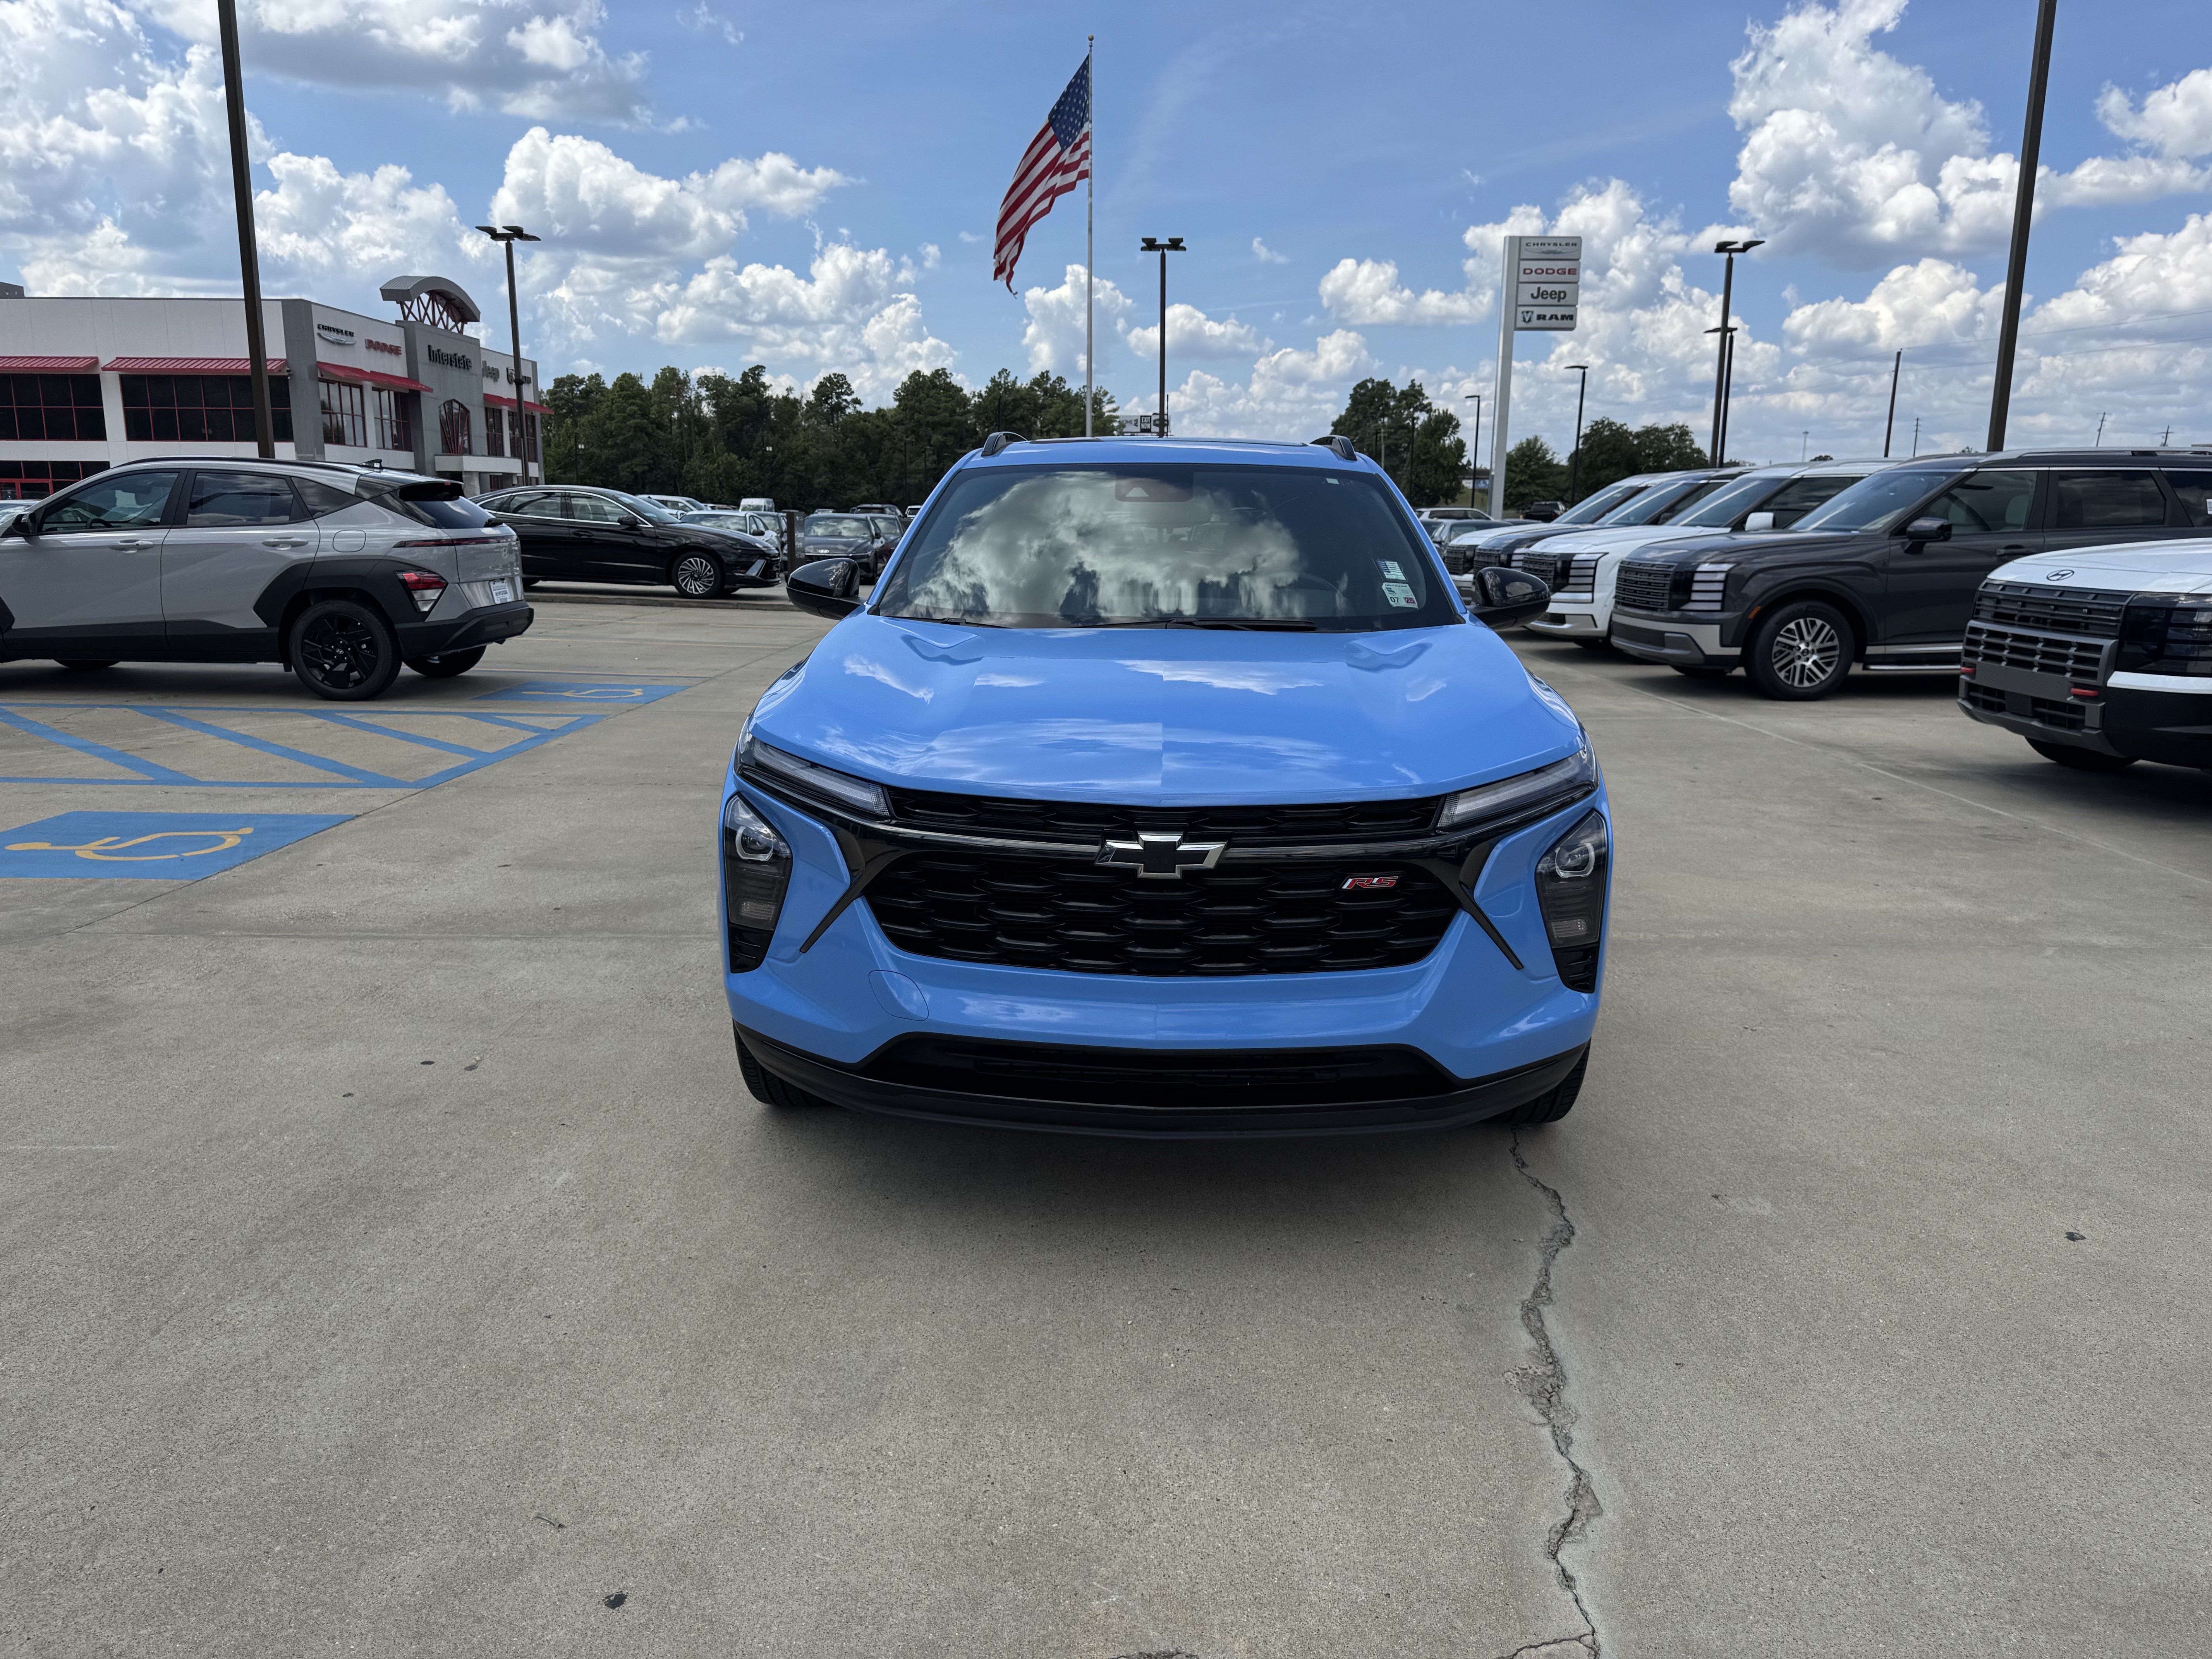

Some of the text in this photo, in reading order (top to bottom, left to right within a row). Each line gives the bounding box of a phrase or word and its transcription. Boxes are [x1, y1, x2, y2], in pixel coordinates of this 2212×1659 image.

[1530, 287, 1566, 302] Jeep
[317, 324, 354, 337] CHRYSLER
[365, 339, 402, 355] DODGE
[428, 344, 472, 370] Interstate
[1342, 876, 1398, 889] RS
